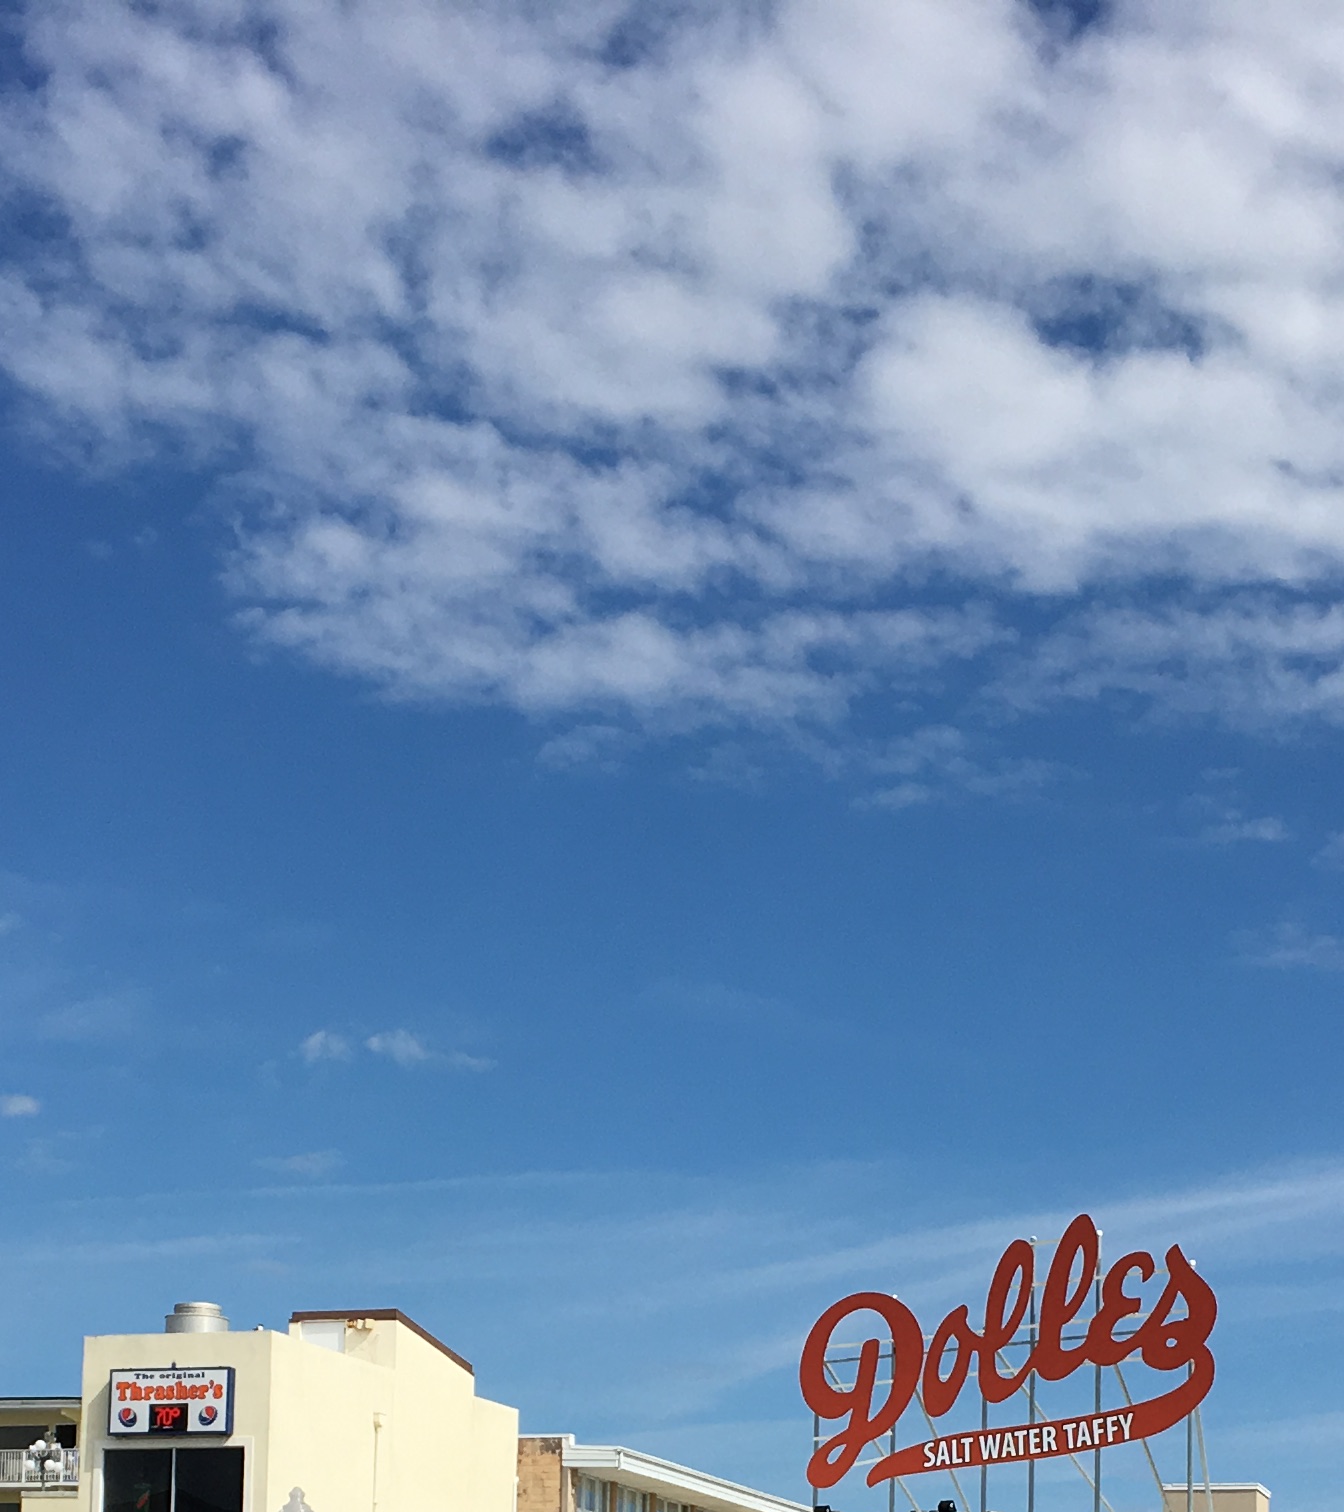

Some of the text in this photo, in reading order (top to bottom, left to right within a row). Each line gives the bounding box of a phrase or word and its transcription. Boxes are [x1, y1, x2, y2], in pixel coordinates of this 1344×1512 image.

[159, 1371, 205, 1380] original
[116, 1379, 224, 1402] Thrasher's
[922, 1412, 1135, 1469] SALT WATER TAFFY
